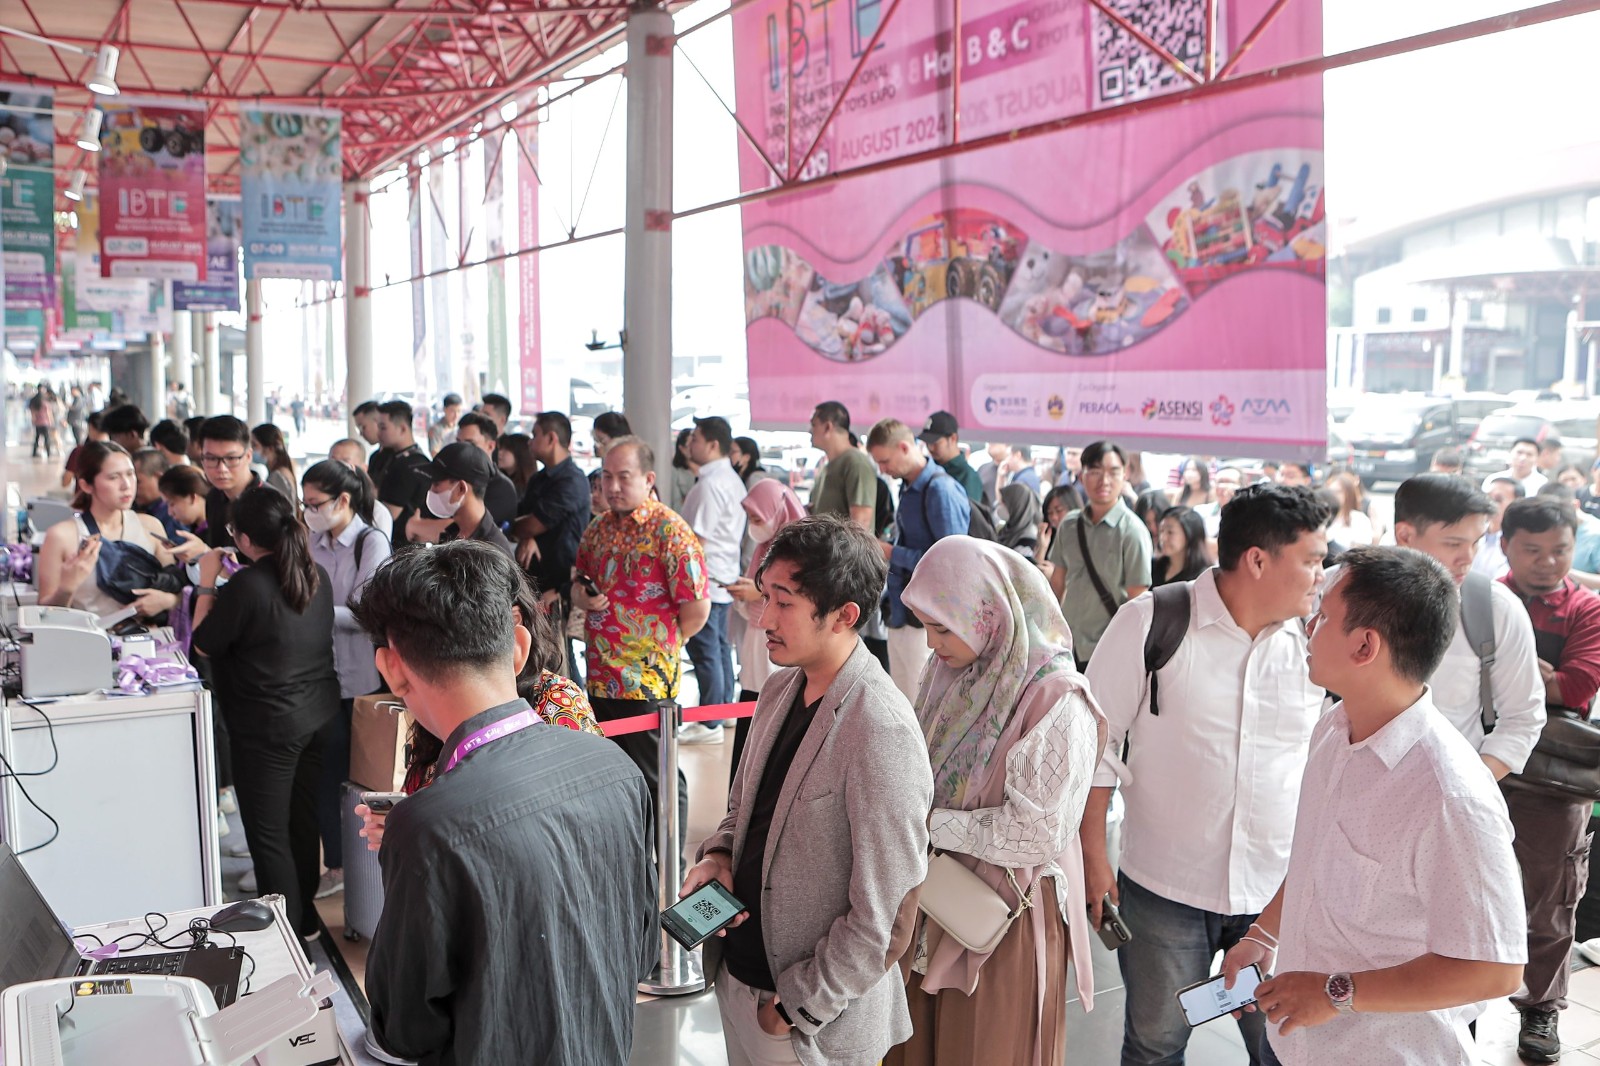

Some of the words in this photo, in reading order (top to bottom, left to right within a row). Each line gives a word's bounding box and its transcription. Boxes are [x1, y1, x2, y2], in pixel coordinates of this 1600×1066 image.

[967, 35, 982, 66] B
[986, 27, 1006, 59] &
[1011, 18, 1030, 50] C
[839, 125, 902, 162] AUGUST
[904, 111, 947, 146] 2024
[1158, 400, 1203, 416] ASENSI
